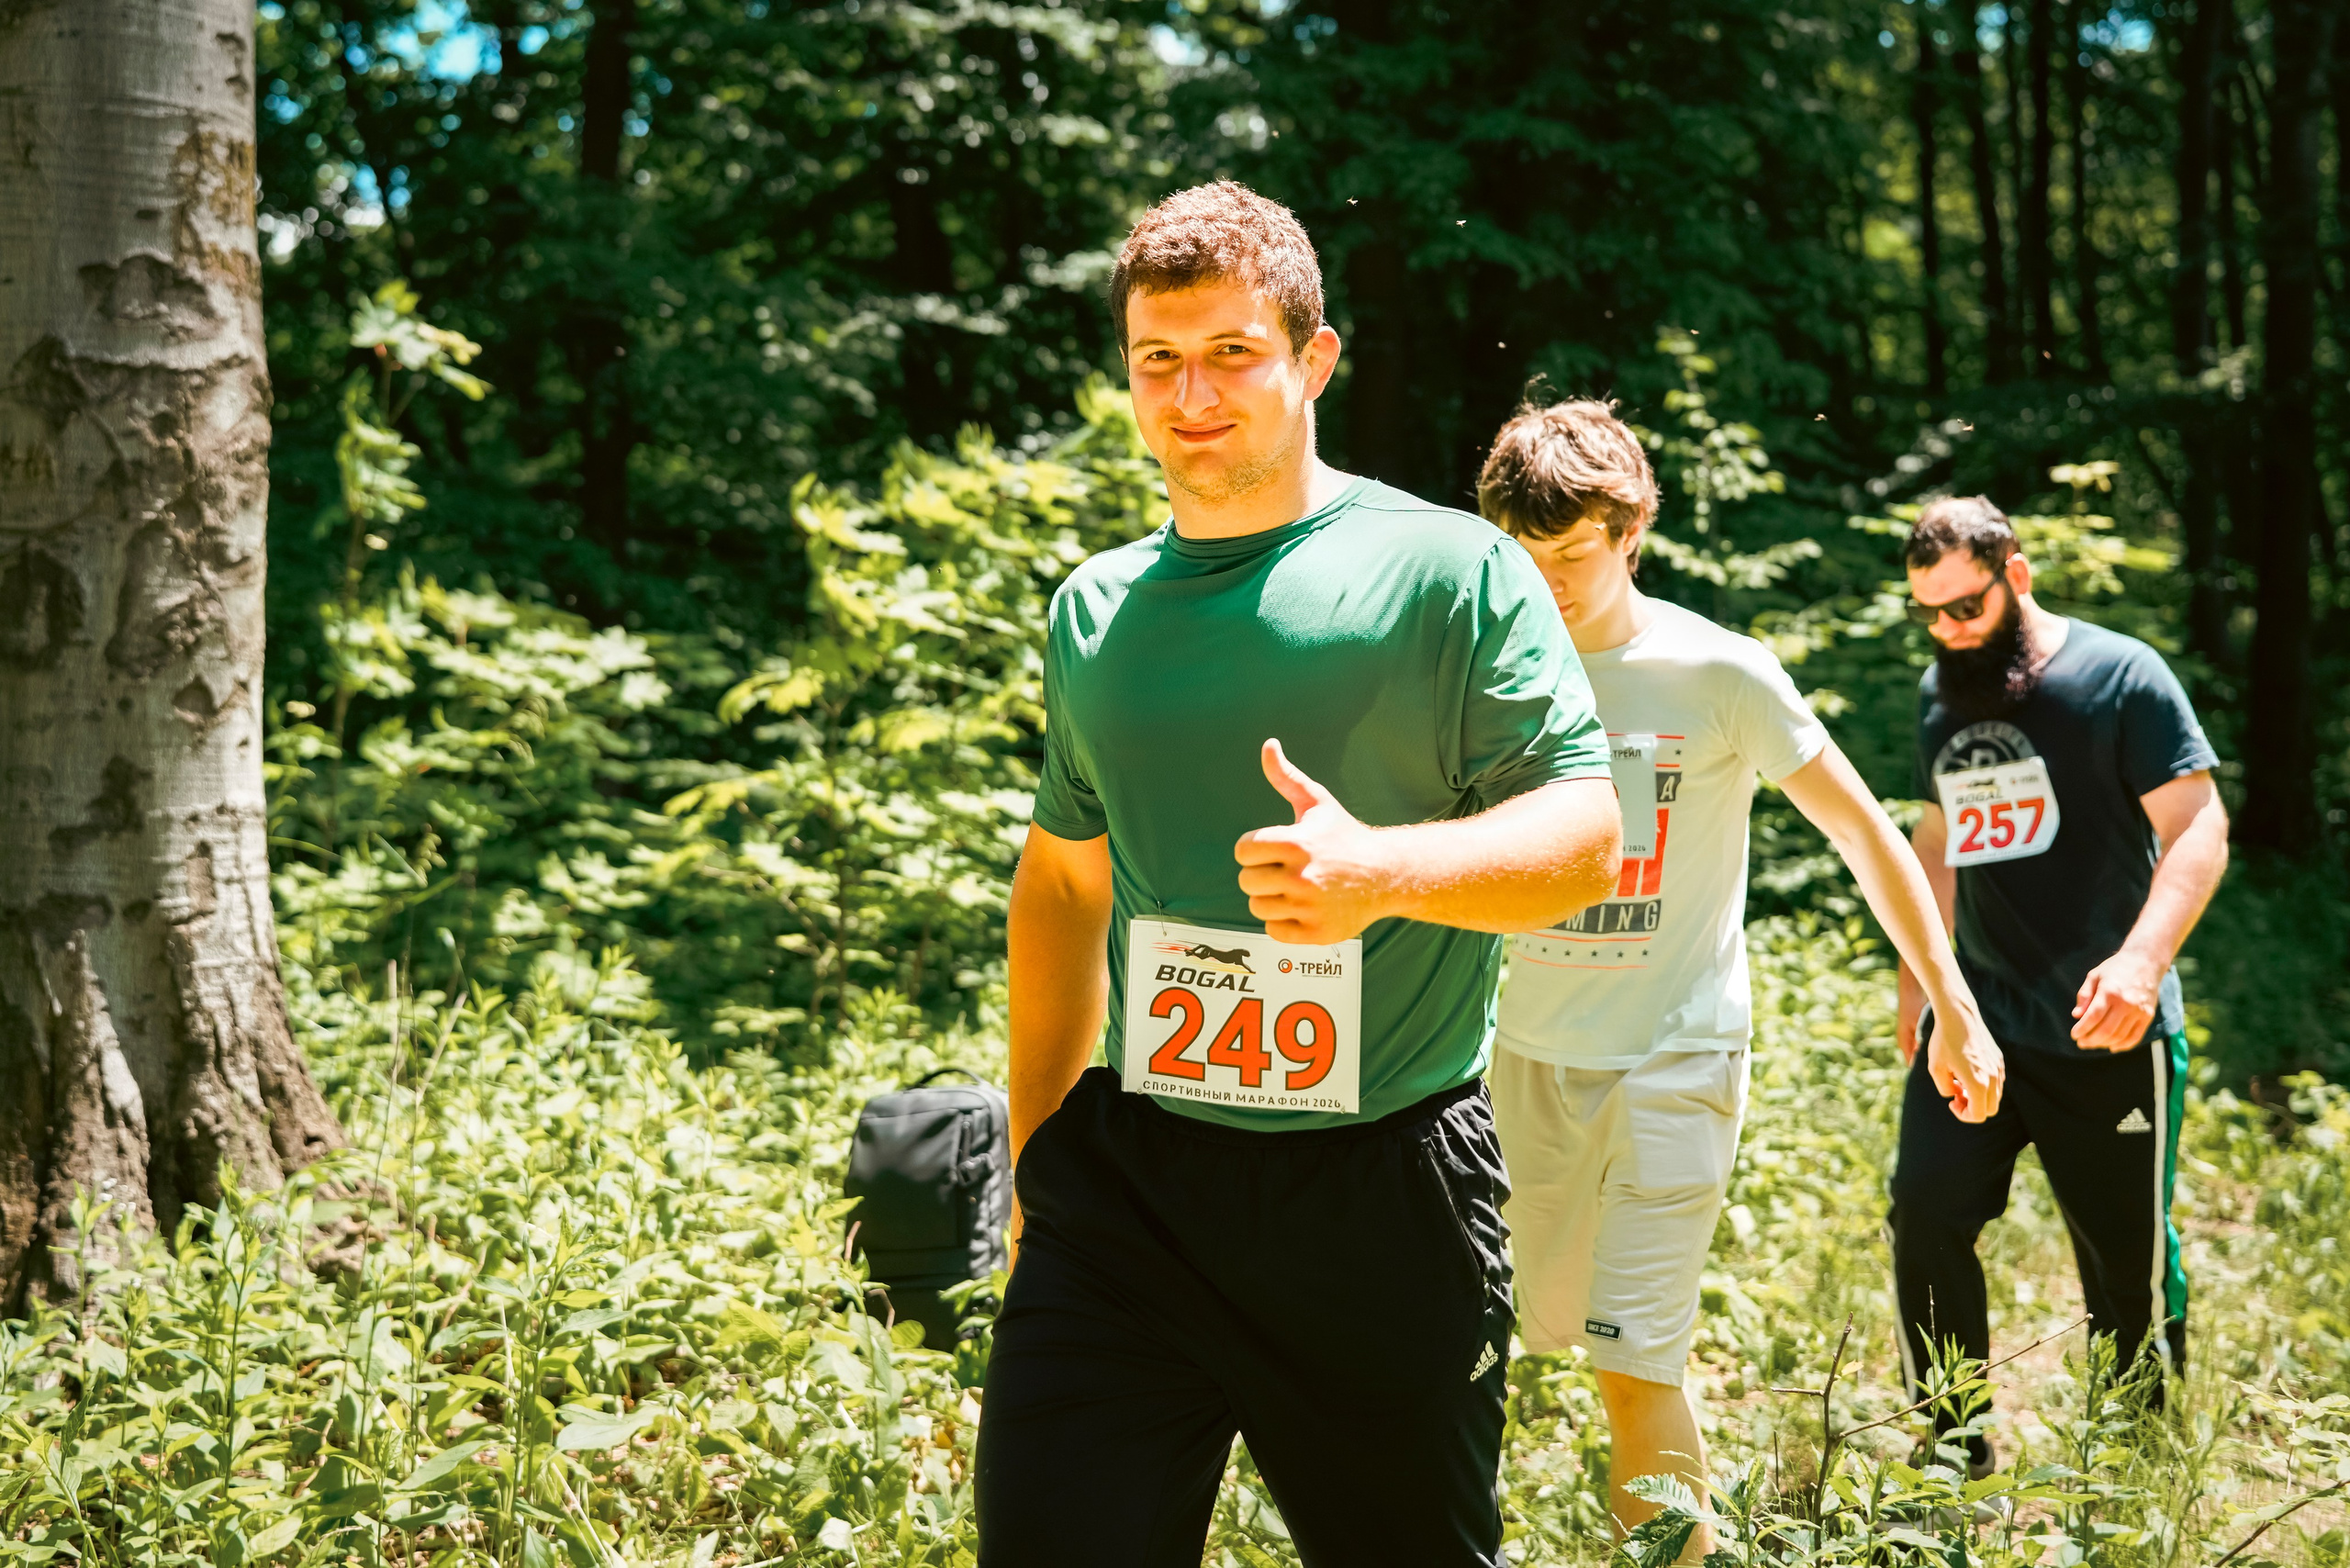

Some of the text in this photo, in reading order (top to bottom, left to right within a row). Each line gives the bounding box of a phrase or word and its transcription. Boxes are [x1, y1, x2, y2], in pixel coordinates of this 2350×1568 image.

[1611, 746, 1642, 758] -ТРЕЙЛ
[1957, 796, 2045, 853] 257
[1628, 844, 1647, 852] 2026
[1565, 901, 1658, 933] MING
[1155, 964, 1256, 993] BOGAL
[1148, 986, 1337, 1091] 249
[1143, 1081, 1341, 1108] СПОРТИВНЫЙ МАРАФОН 2026
[1470, 1352, 1499, 1382] adidas
